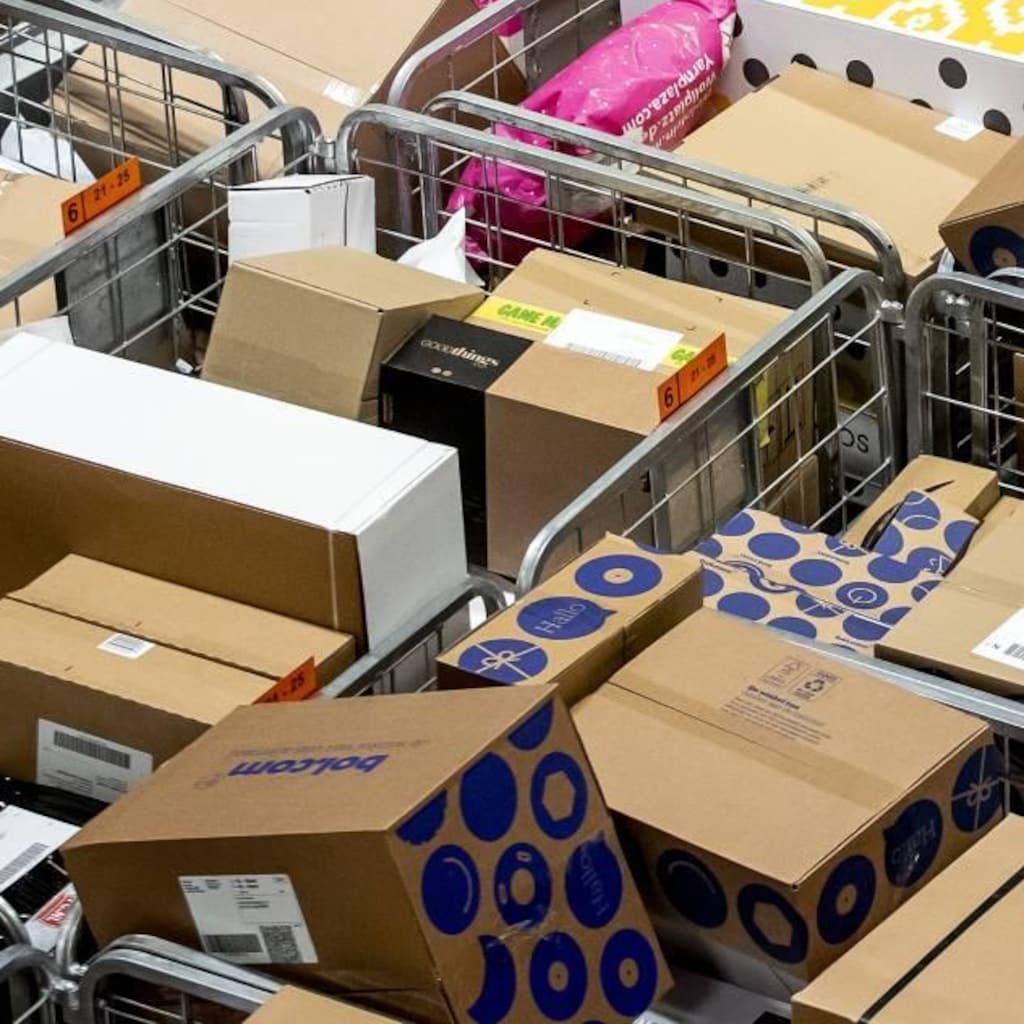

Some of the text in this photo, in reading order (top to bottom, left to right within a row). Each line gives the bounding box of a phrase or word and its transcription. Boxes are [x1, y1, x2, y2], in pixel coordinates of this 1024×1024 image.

[621, 53, 714, 134] Yarnplaza.com
[68, 202, 78, 223] 6
[94, 186, 106, 201] 21
[117, 170, 130, 186] 25
[498, 304, 543, 325] GAME
[664, 387, 673, 407] 6
[690, 366, 700, 382] 21
[534, 603, 586, 634] Hallo
[228, 754, 389, 776] bol.com
